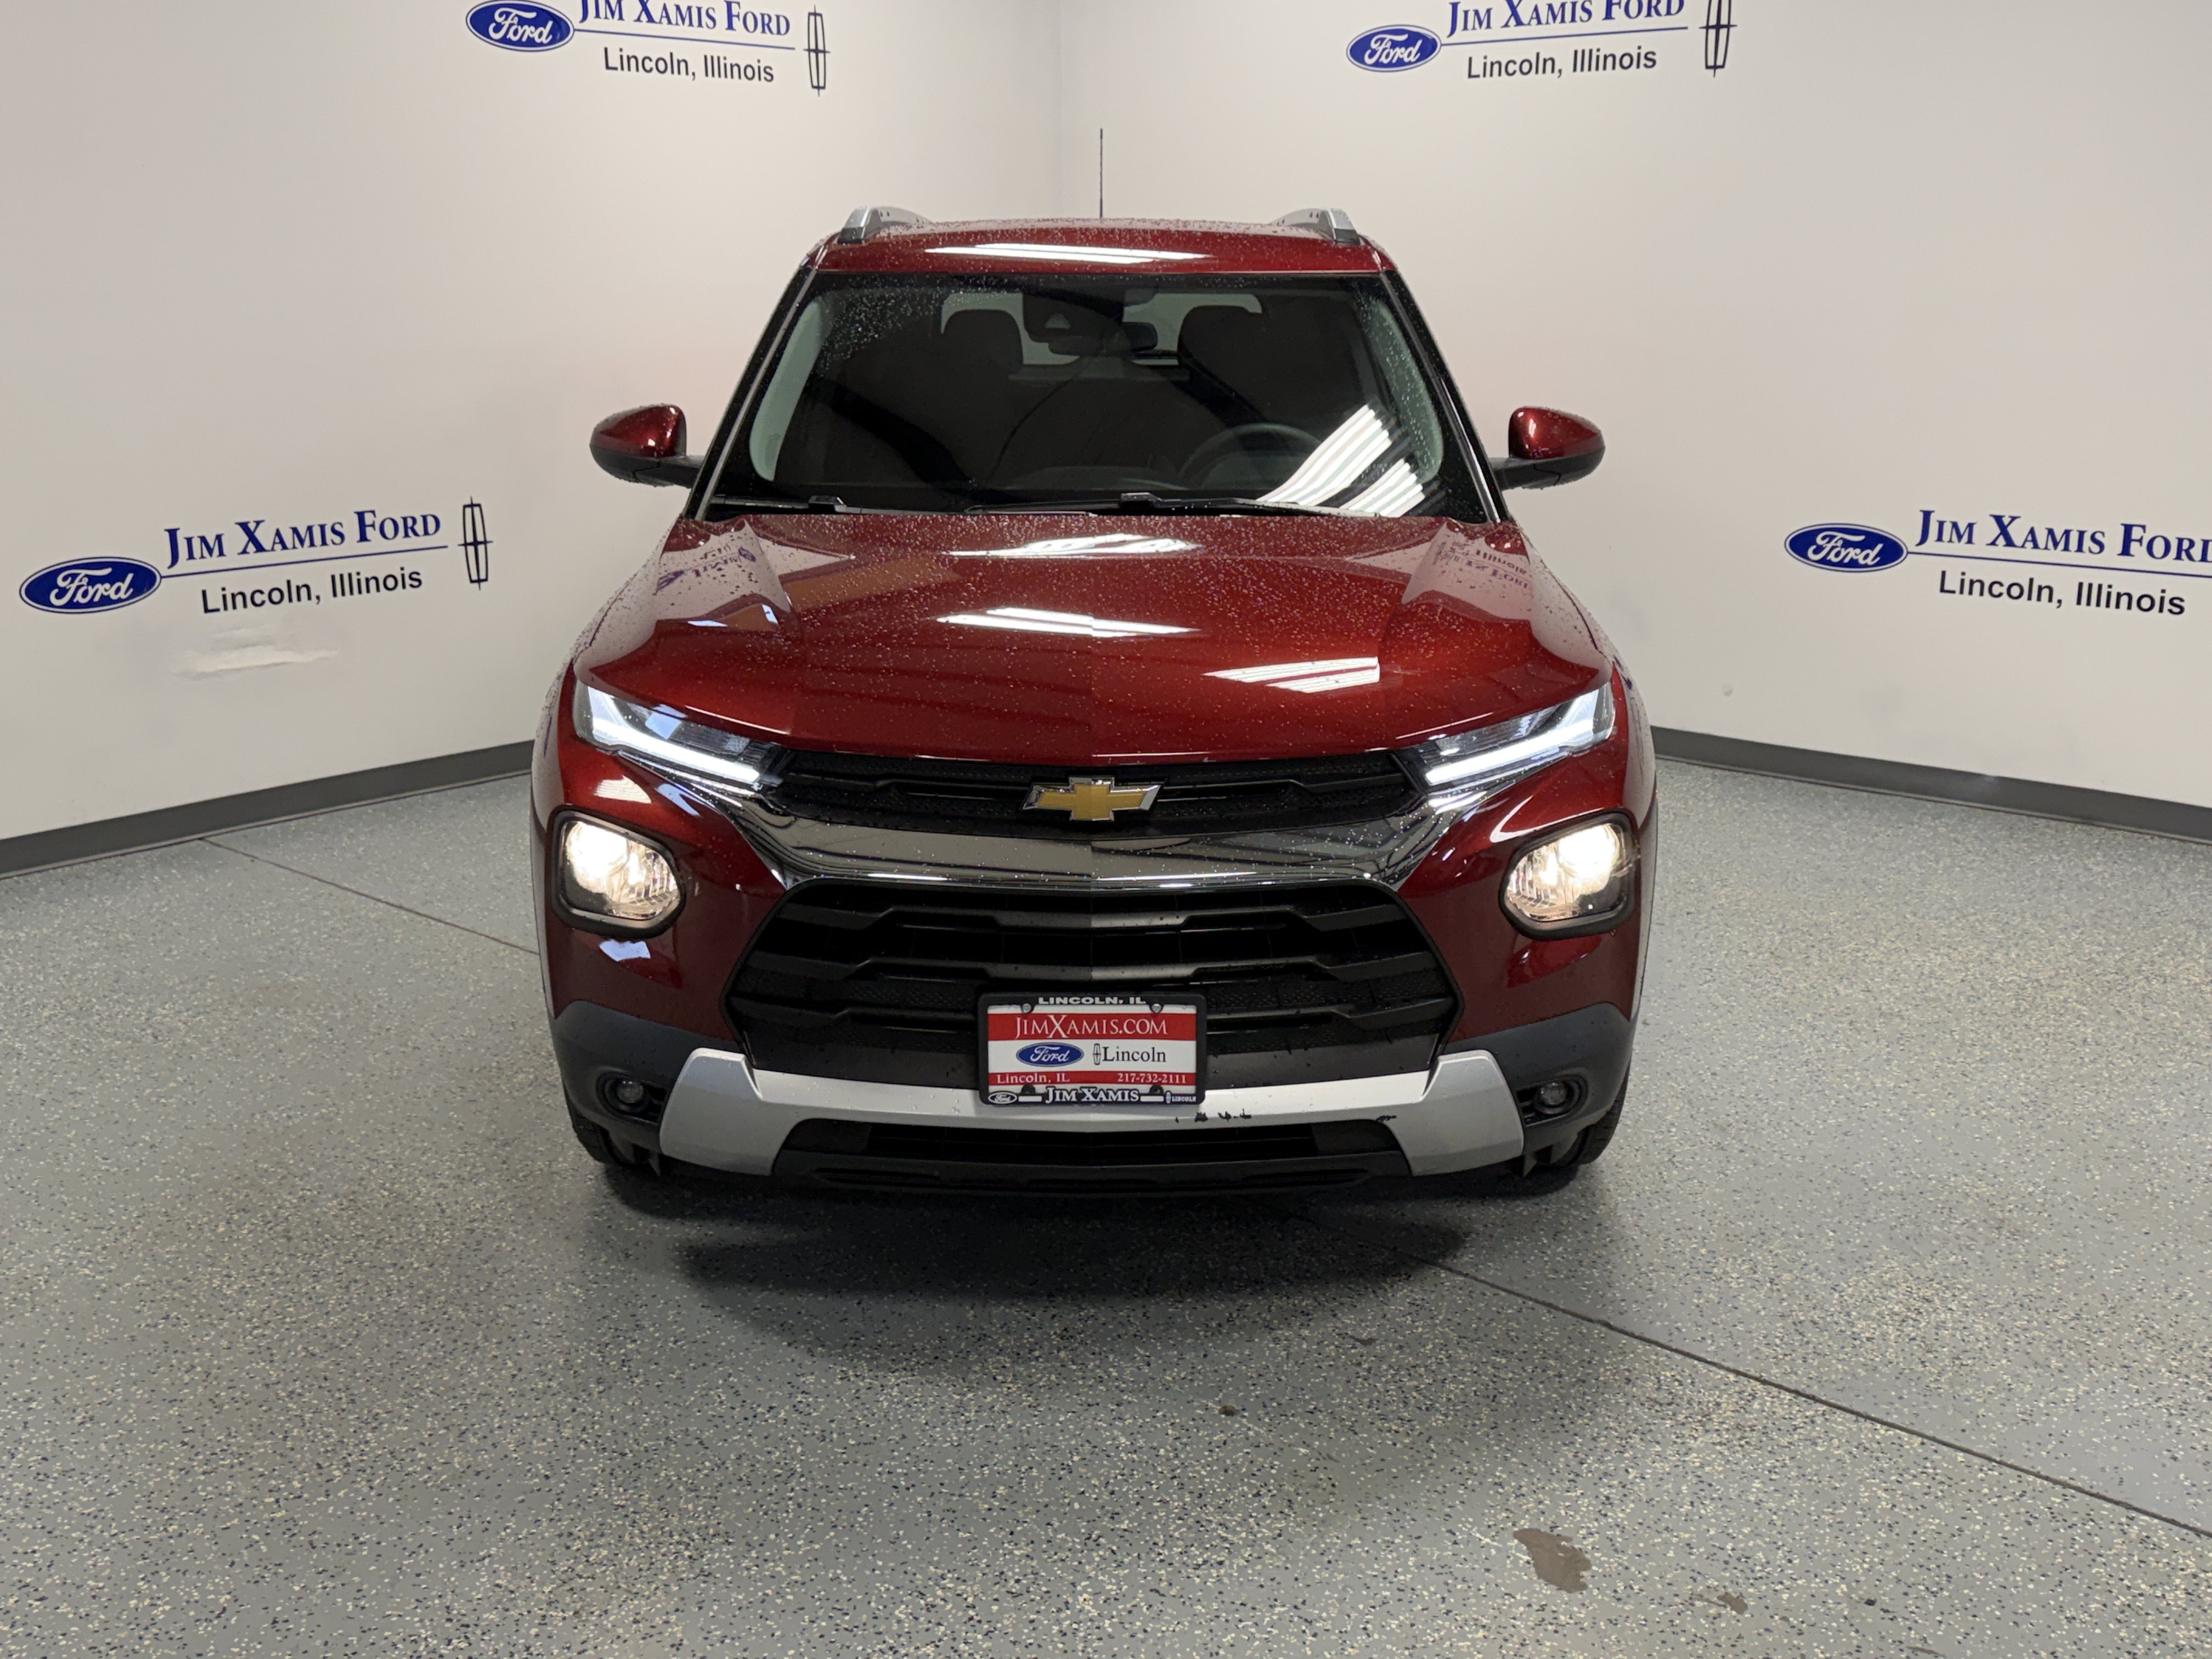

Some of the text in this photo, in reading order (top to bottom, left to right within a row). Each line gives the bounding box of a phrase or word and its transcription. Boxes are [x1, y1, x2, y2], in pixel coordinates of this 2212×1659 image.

[489, 7, 553, 45] Ford
[579, 0, 791, 36] JIM XAMIS FORD
[1447, 0, 1685, 38] JIM XAMIS FORD
[604, 47, 774, 82] Lincoln, Illinois
[1364, 33, 1421, 65] Ford
[1467, 46, 1657, 79] Lincoln, Illinois
[165, 510, 441, 569] JIM XAMIS FORD
[1808, 531, 1883, 567] Ford
[1915, 510, 2212, 563] JIM XAMIS FORD
[50, 567, 134, 606] Ford
[201, 567, 422, 613] Lincoln, Illinois
[1939, 570, 2186, 616] Lincoln, Illinois
[1038, 996, 1147, 1005] LINCOLN, IL
[1015, 1014, 1168, 1039] JIMXAMIS.COM
[1030, 1046, 1166, 1063] Ford Lincoln
[997, 1073, 1070, 1084] Lincoln, IL
[1045, 1087, 1140, 1103] JIM XAMIS
[1117, 1073, 1187, 1084] 217-732-2111
